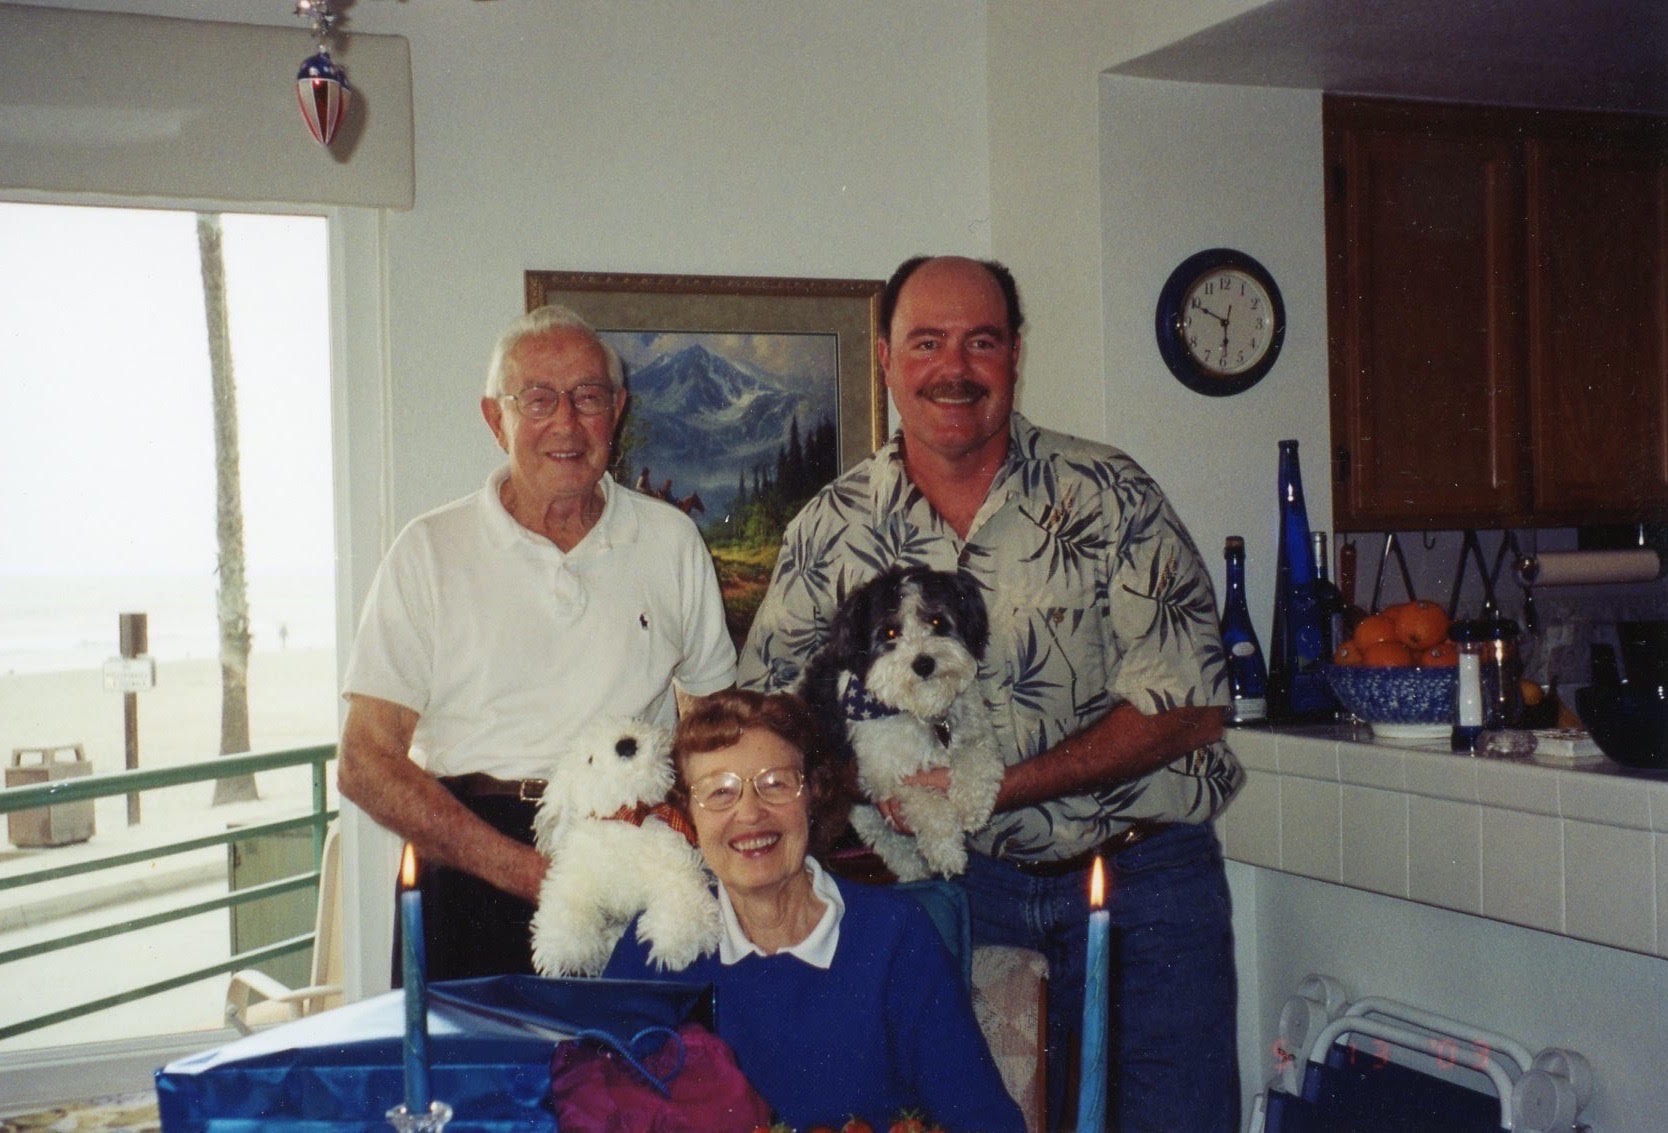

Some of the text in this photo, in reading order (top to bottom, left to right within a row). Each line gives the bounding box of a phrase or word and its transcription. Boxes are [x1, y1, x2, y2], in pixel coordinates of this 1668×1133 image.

[1205, 283, 1213, 295] 11
[1220, 278, 1231, 290] 12
[1250, 298, 1259, 309] 2
[1256, 317, 1263, 329] 3
[1205, 349, 1211, 362] 7
[1237, 350, 1244, 362] 5
